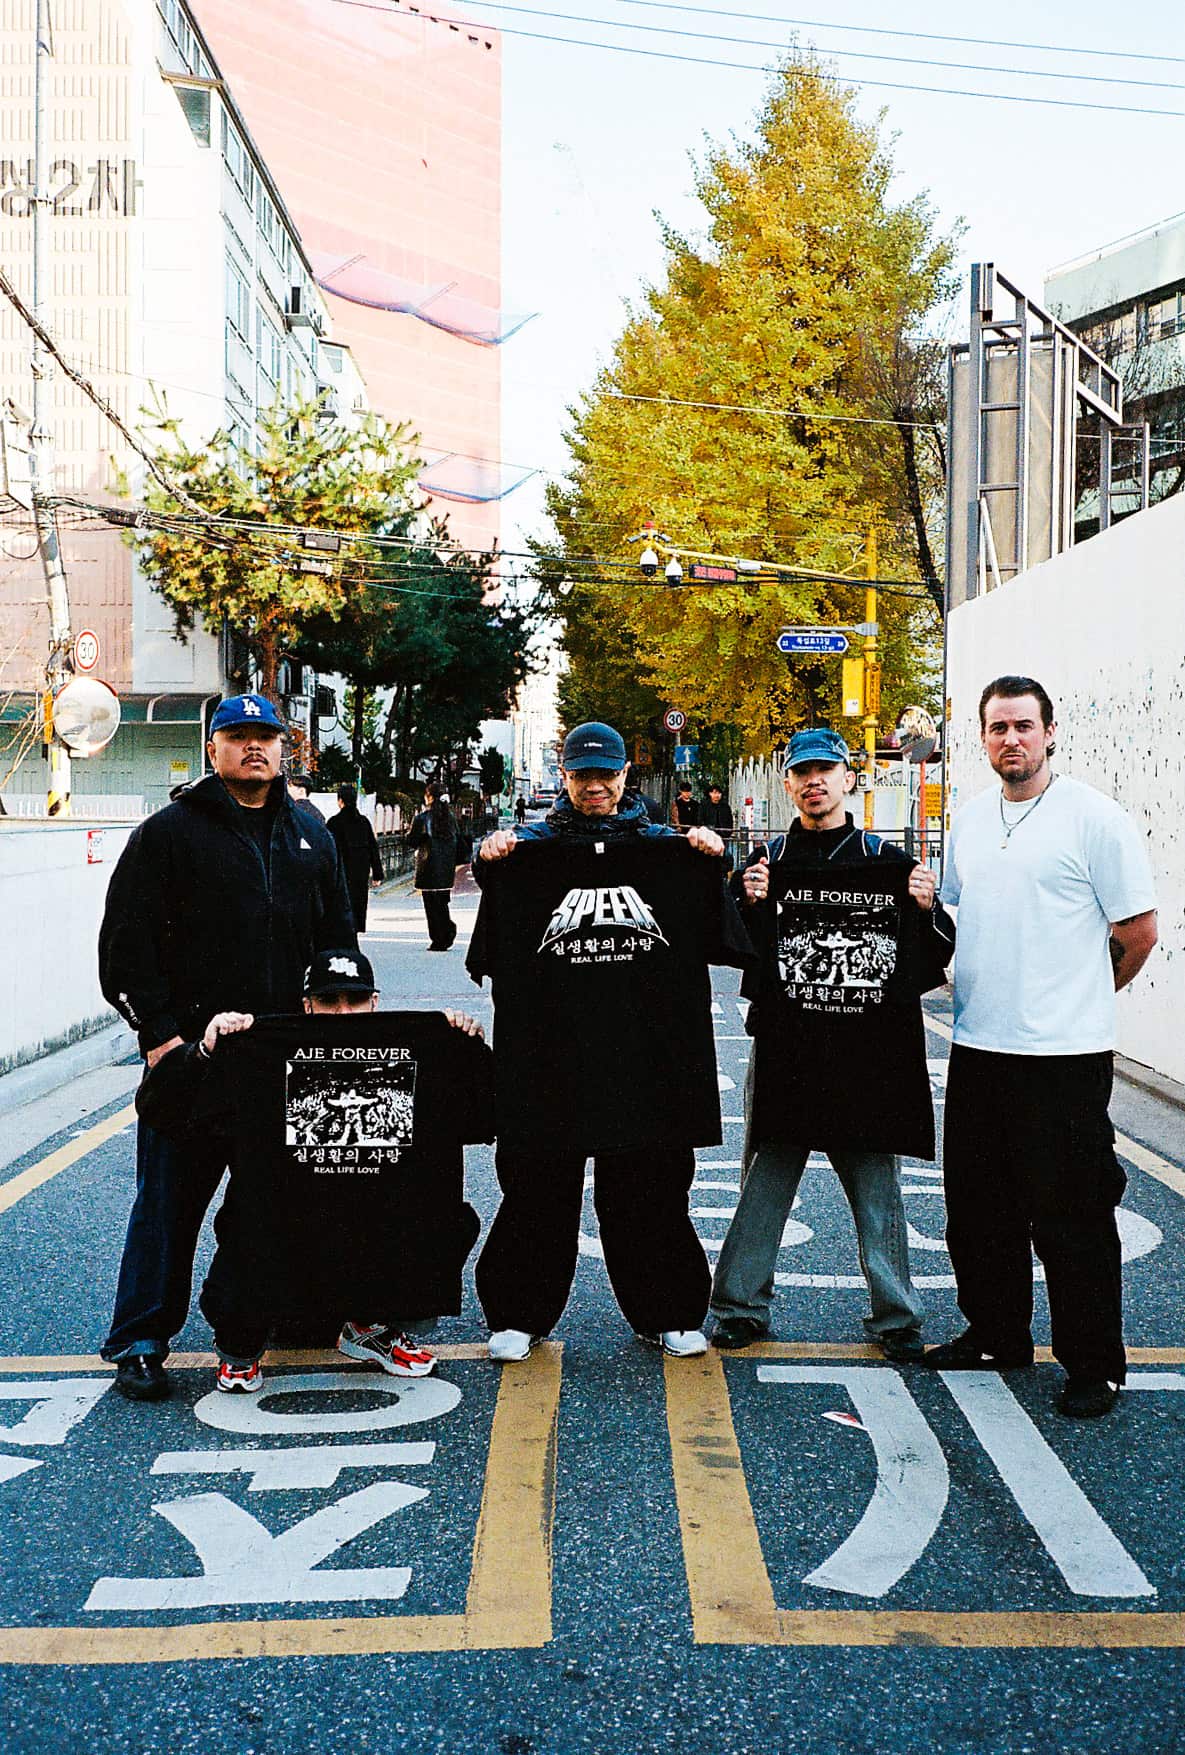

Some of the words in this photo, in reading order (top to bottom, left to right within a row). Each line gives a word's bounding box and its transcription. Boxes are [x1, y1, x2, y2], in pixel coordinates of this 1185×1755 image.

[80, 641, 95, 660] 30
[242, 698, 261, 716] LA
[668, 714, 683, 726] 30
[784, 889, 813, 901] AJE
[820, 890, 895, 906] FOREVER
[543, 885, 665, 944] SPEED
[550, 937, 615, 956] 실생활의
[621, 936, 655, 951] 사랑
[570, 955, 592, 964] REAL
[594, 954, 612, 963] LIFE
[613, 953, 634, 962] LOVE
[784, 984, 845, 1004] 실생활의
[852, 988, 884, 1004] 사랑
[802, 1002, 823, 1011] REAL
[824, 1004, 842, 1013] LIFE
[843, 1005, 865, 1014] LOVE
[293, 1047, 325, 1060] AJE
[332, 1047, 412, 1060] FOREVER
[293, 1147, 359, 1164] 실생활의
[367, 1147, 402, 1164] 사랑
[313, 1166, 336, 1174] REAL
[337, 1166, 355, 1174] LIFE
[357, 1166, 380, 1174] LOVE
